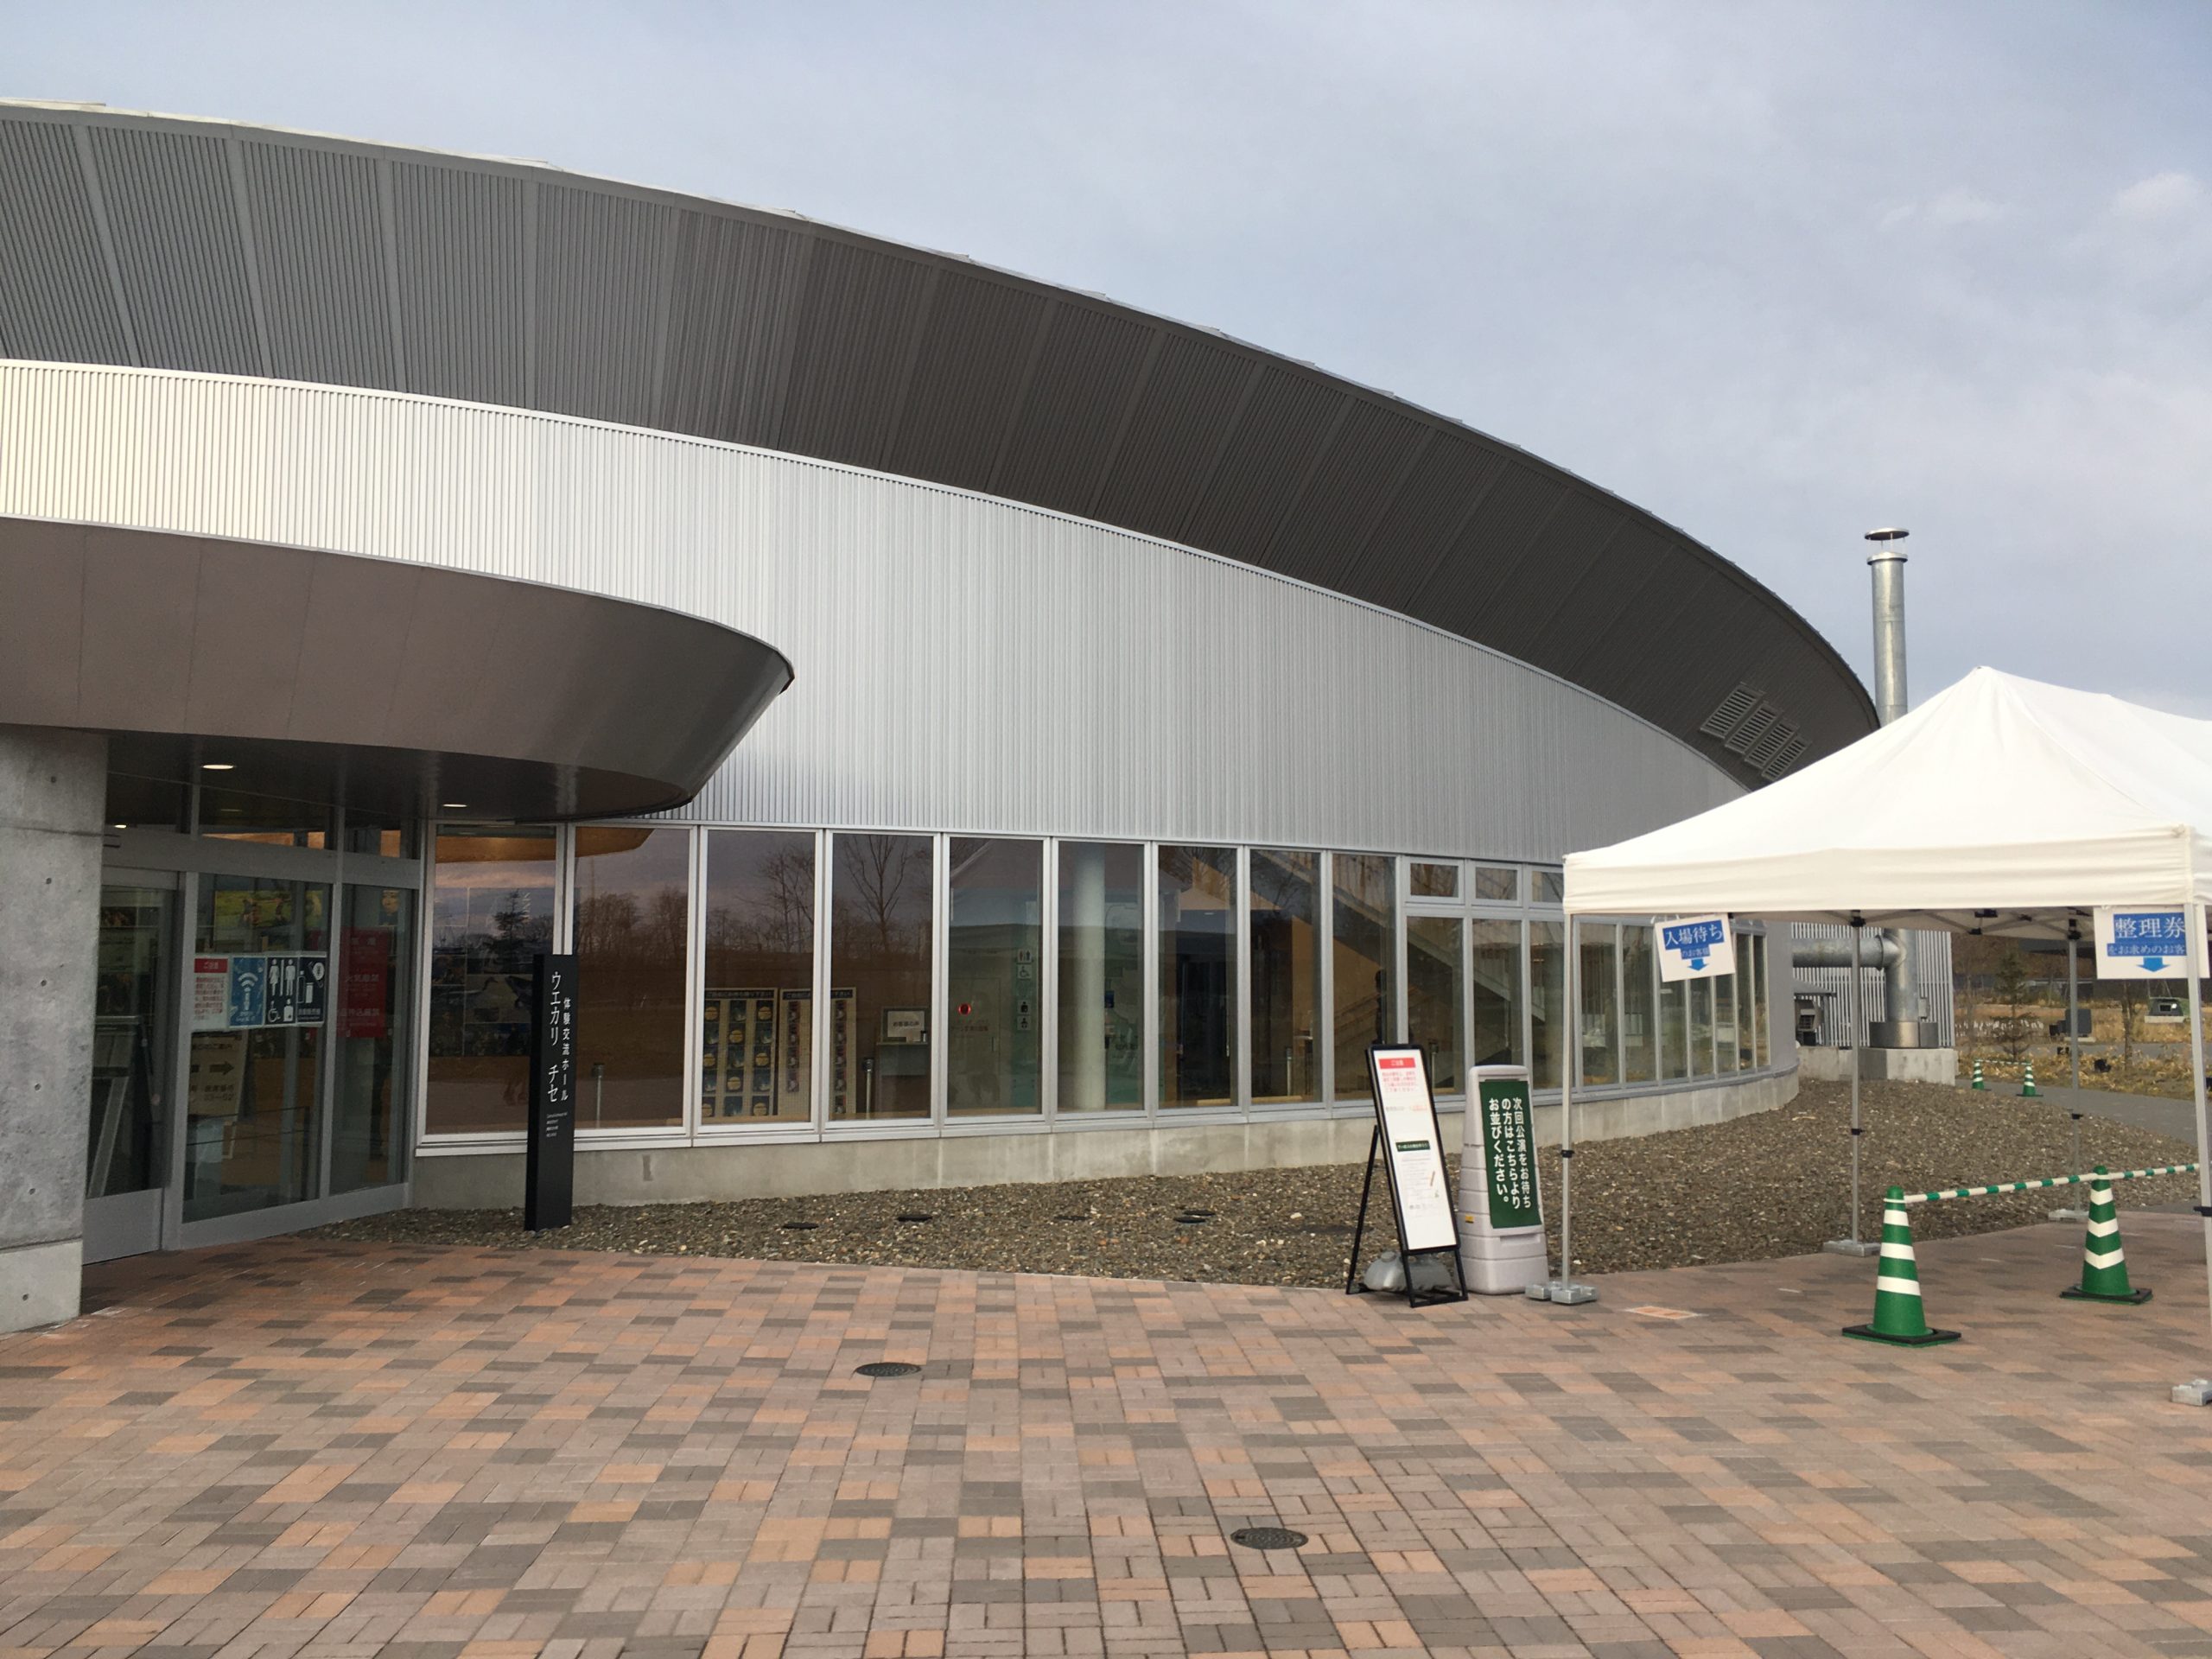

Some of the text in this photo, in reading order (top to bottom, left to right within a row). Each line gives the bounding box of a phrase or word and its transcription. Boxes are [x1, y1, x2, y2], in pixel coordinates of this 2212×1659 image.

[1666, 925, 1722, 946] 入場待ち
[2108, 944, 2185, 955] をお求めのお客
[2115, 917, 2185, 938] 整理券
[547, 1064, 559, 1103] チセ
[561, 997, 570, 1101] 体験交流ホール
[1489, 1097, 1509, 1203] お並びください。
[1502, 1097, 1521, 1210] の方はこちらより
[1513, 1097, 1531, 1209] 次回公演をお待ち
